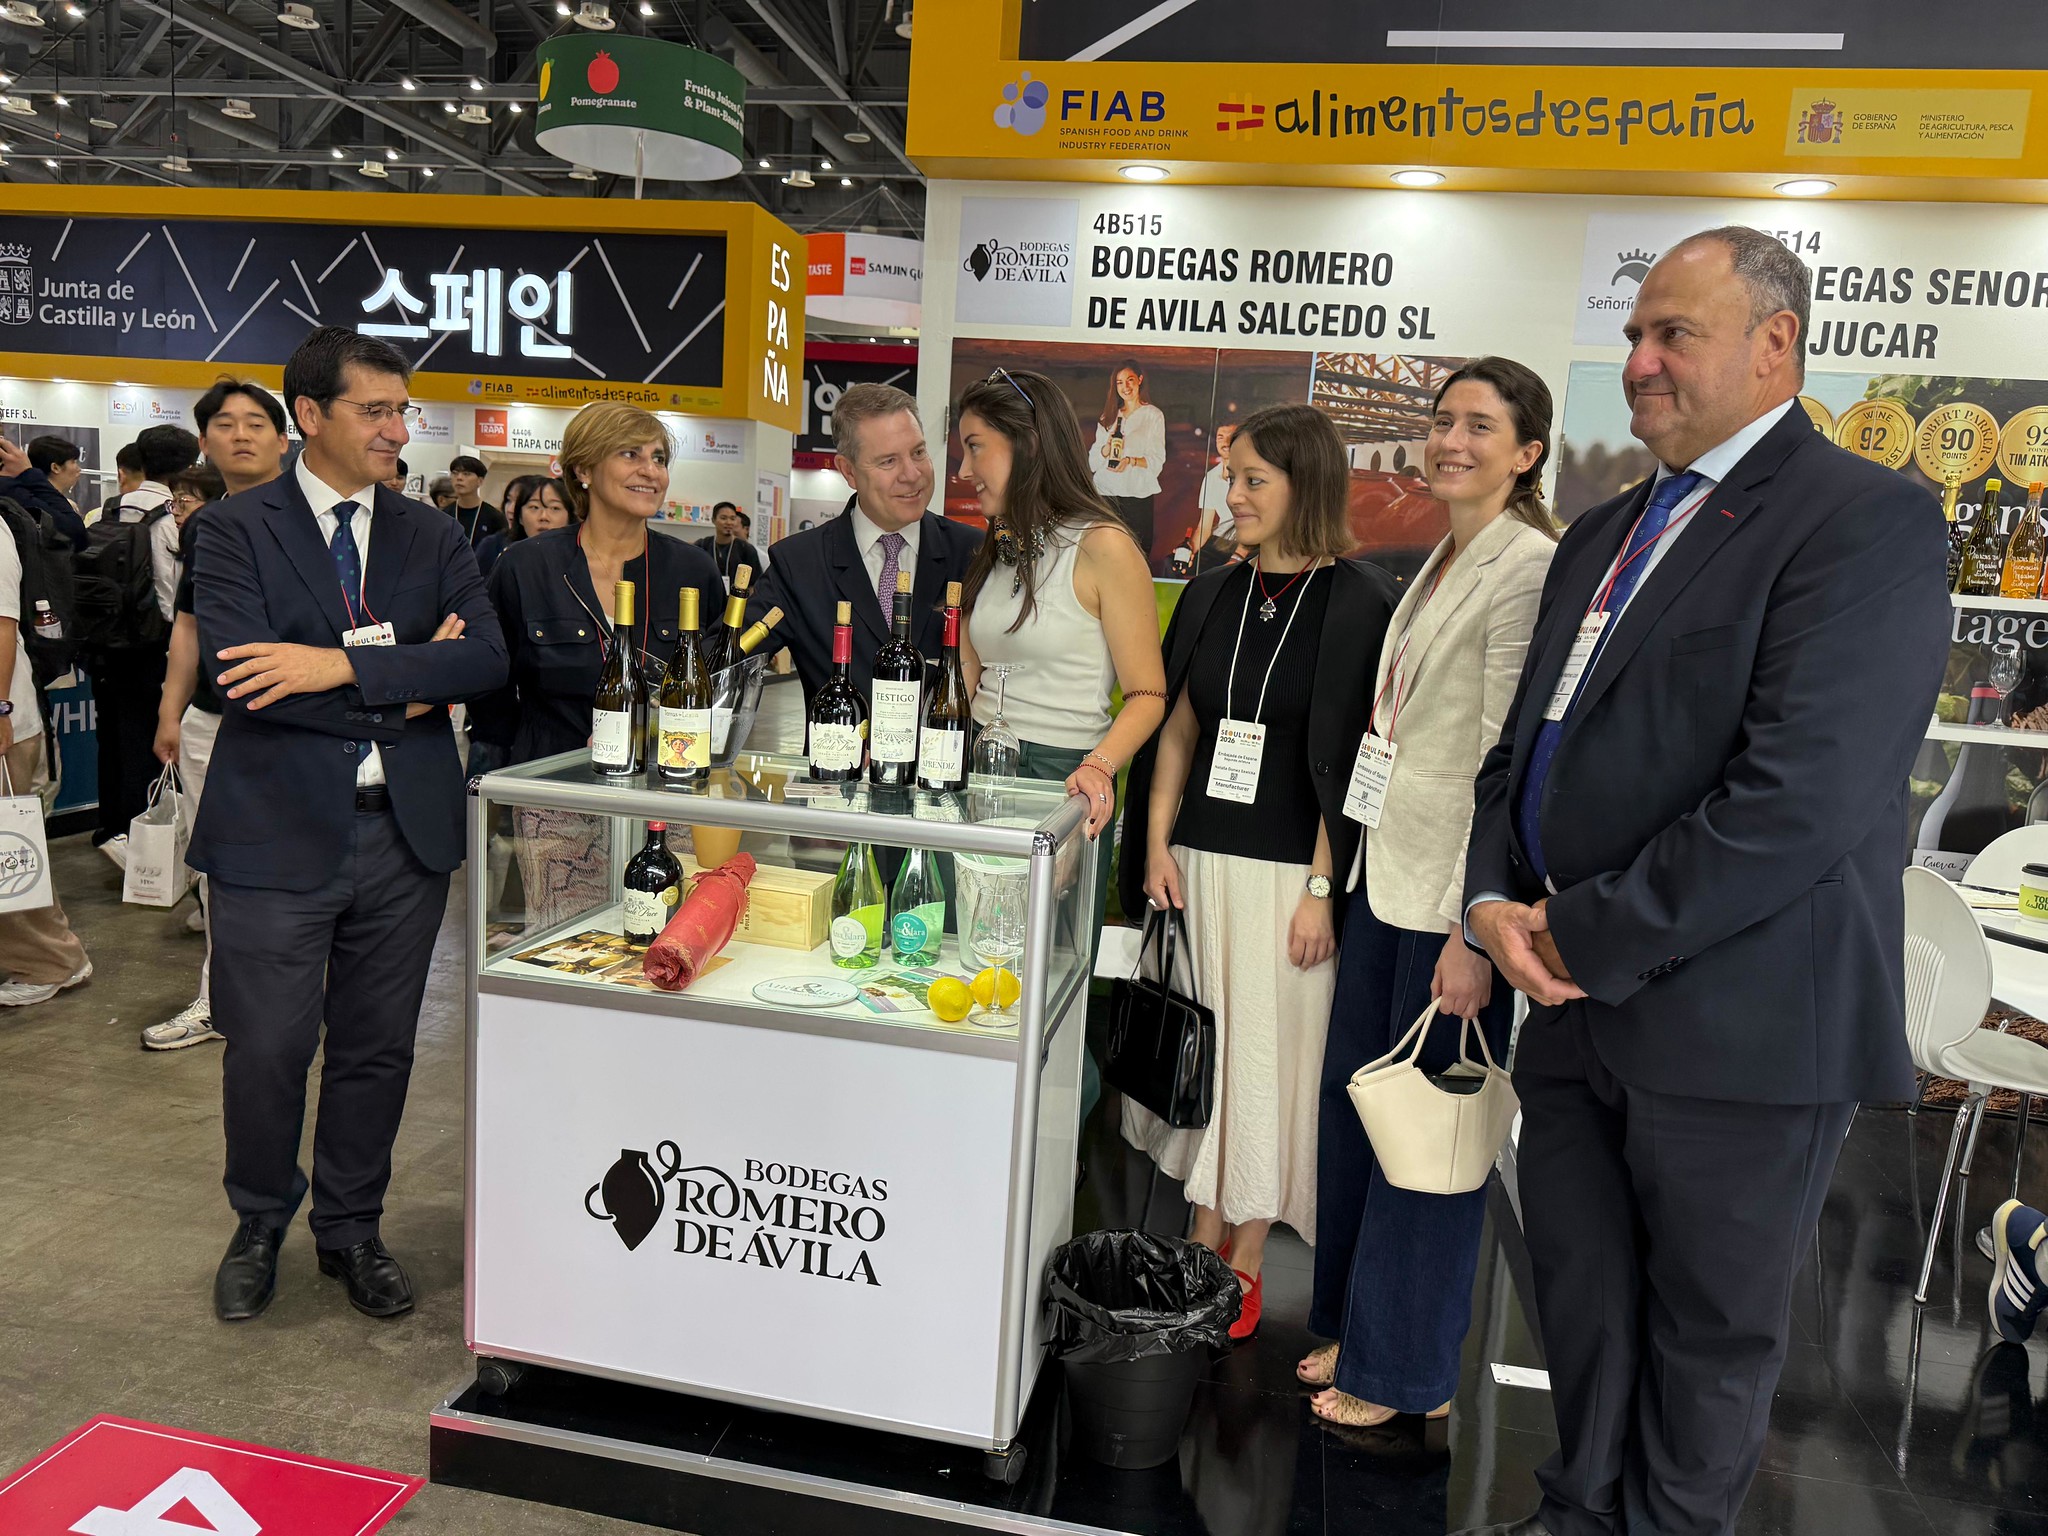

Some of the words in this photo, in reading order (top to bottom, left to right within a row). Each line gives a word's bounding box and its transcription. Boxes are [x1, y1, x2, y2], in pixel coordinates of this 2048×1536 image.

[684, 79, 716, 99] Fruits
[571, 97, 637, 108] Pomegranate
[684, 95, 693, 108] &
[1061, 90, 1166, 122] FIAB
[1275, 87, 1755, 145] alimentosdespaña
[1853, 113, 1898, 121] GOBIERNO
[1865, 119, 1896, 130] ESPAÑA
[1919, 123, 1930, 131] DE
[1931, 123, 1988, 132] AGRICULTURA,
[1060, 128, 1100, 136] SPANISH
[1103, 128, 1131, 137] FOOD
[1134, 129, 1155, 137] AND
[1158, 129, 1189, 138] DRINK
[1918, 132, 1924, 140] Y
[1925, 131, 1984, 140] ALIMENTACIÓN
[1059, 141, 1106, 150] INDUSTRY
[1109, 142, 1171, 151] FEDERATION
[1093, 213, 1162, 235] 4B515
[1020, 241, 1070, 252] BODEGAS
[771, 242, 790, 292] ES
[996, 252, 1069, 268] ROMERO
[1091, 246, 1239, 282] BODEGAS
[1249, 250, 1393, 287] ROMERO
[808, 264, 832, 276] TASTE
[868, 263, 907, 277] SAMJIN
[994, 267, 1016, 282] DE
[1017, 266, 1067, 284] ÁVILA
[39, 277, 100, 299] Junta
[107, 280, 135, 300] de
[39, 304, 116, 327] Castilla
[121, 312, 135, 333] y
[142, 308, 196, 330] León
[357, 267, 573, 358] 스페인
[1087, 296, 1128, 329] DE
[1136, 298, 1227, 333] AVILA
[1238, 301, 1387, 339] SALCEDO
[1397, 306, 1436, 340] SL
[767, 299, 789, 350] PA
[1809, 321, 1939, 359] JUCAR
[763, 348, 789, 406] ÑA
[485, 383, 513, 393] FIAB
[541, 385, 660, 403] alimentosdespaña
[22, 409, 37, 420] S.L.
[1863, 410, 1893, 423] WINE
[479, 422, 505, 435] TRAPA
[1921, 409, 1961, 451] ROBERT
[1964, 410, 1993, 454] PARKER
[512, 438, 541, 449] TRAPA
[1859, 426, 1888, 451] 92
[1940, 428, 1975, 451] 90
[1941, 452, 1967, 460] POINTS
[2009, 453, 2028, 466] TIM
[347, 637, 370, 647] SEOUL
[371, 633, 392, 642] FOOD
[876, 692, 915, 702] TESTIGO
[1219, 735, 1235, 744] 2026
[1220, 729, 1241, 738] SEOUL
[1243, 733, 1262, 741] FOOD
[1362, 742, 1377, 755] SEOUL
[1377, 749, 1392, 760] FOOD
[922, 760, 955, 770] APRENDIZ
[1215, 781, 1250, 791] Manufacturer
[1923, 855, 1957, 870] Cueva
[744, 1158, 888, 1201] BODEGAS
[675, 1176, 886, 1242] ROMERO
[673, 1219, 734, 1261] DE
[737, 1225, 882, 1287] ÁVILA
